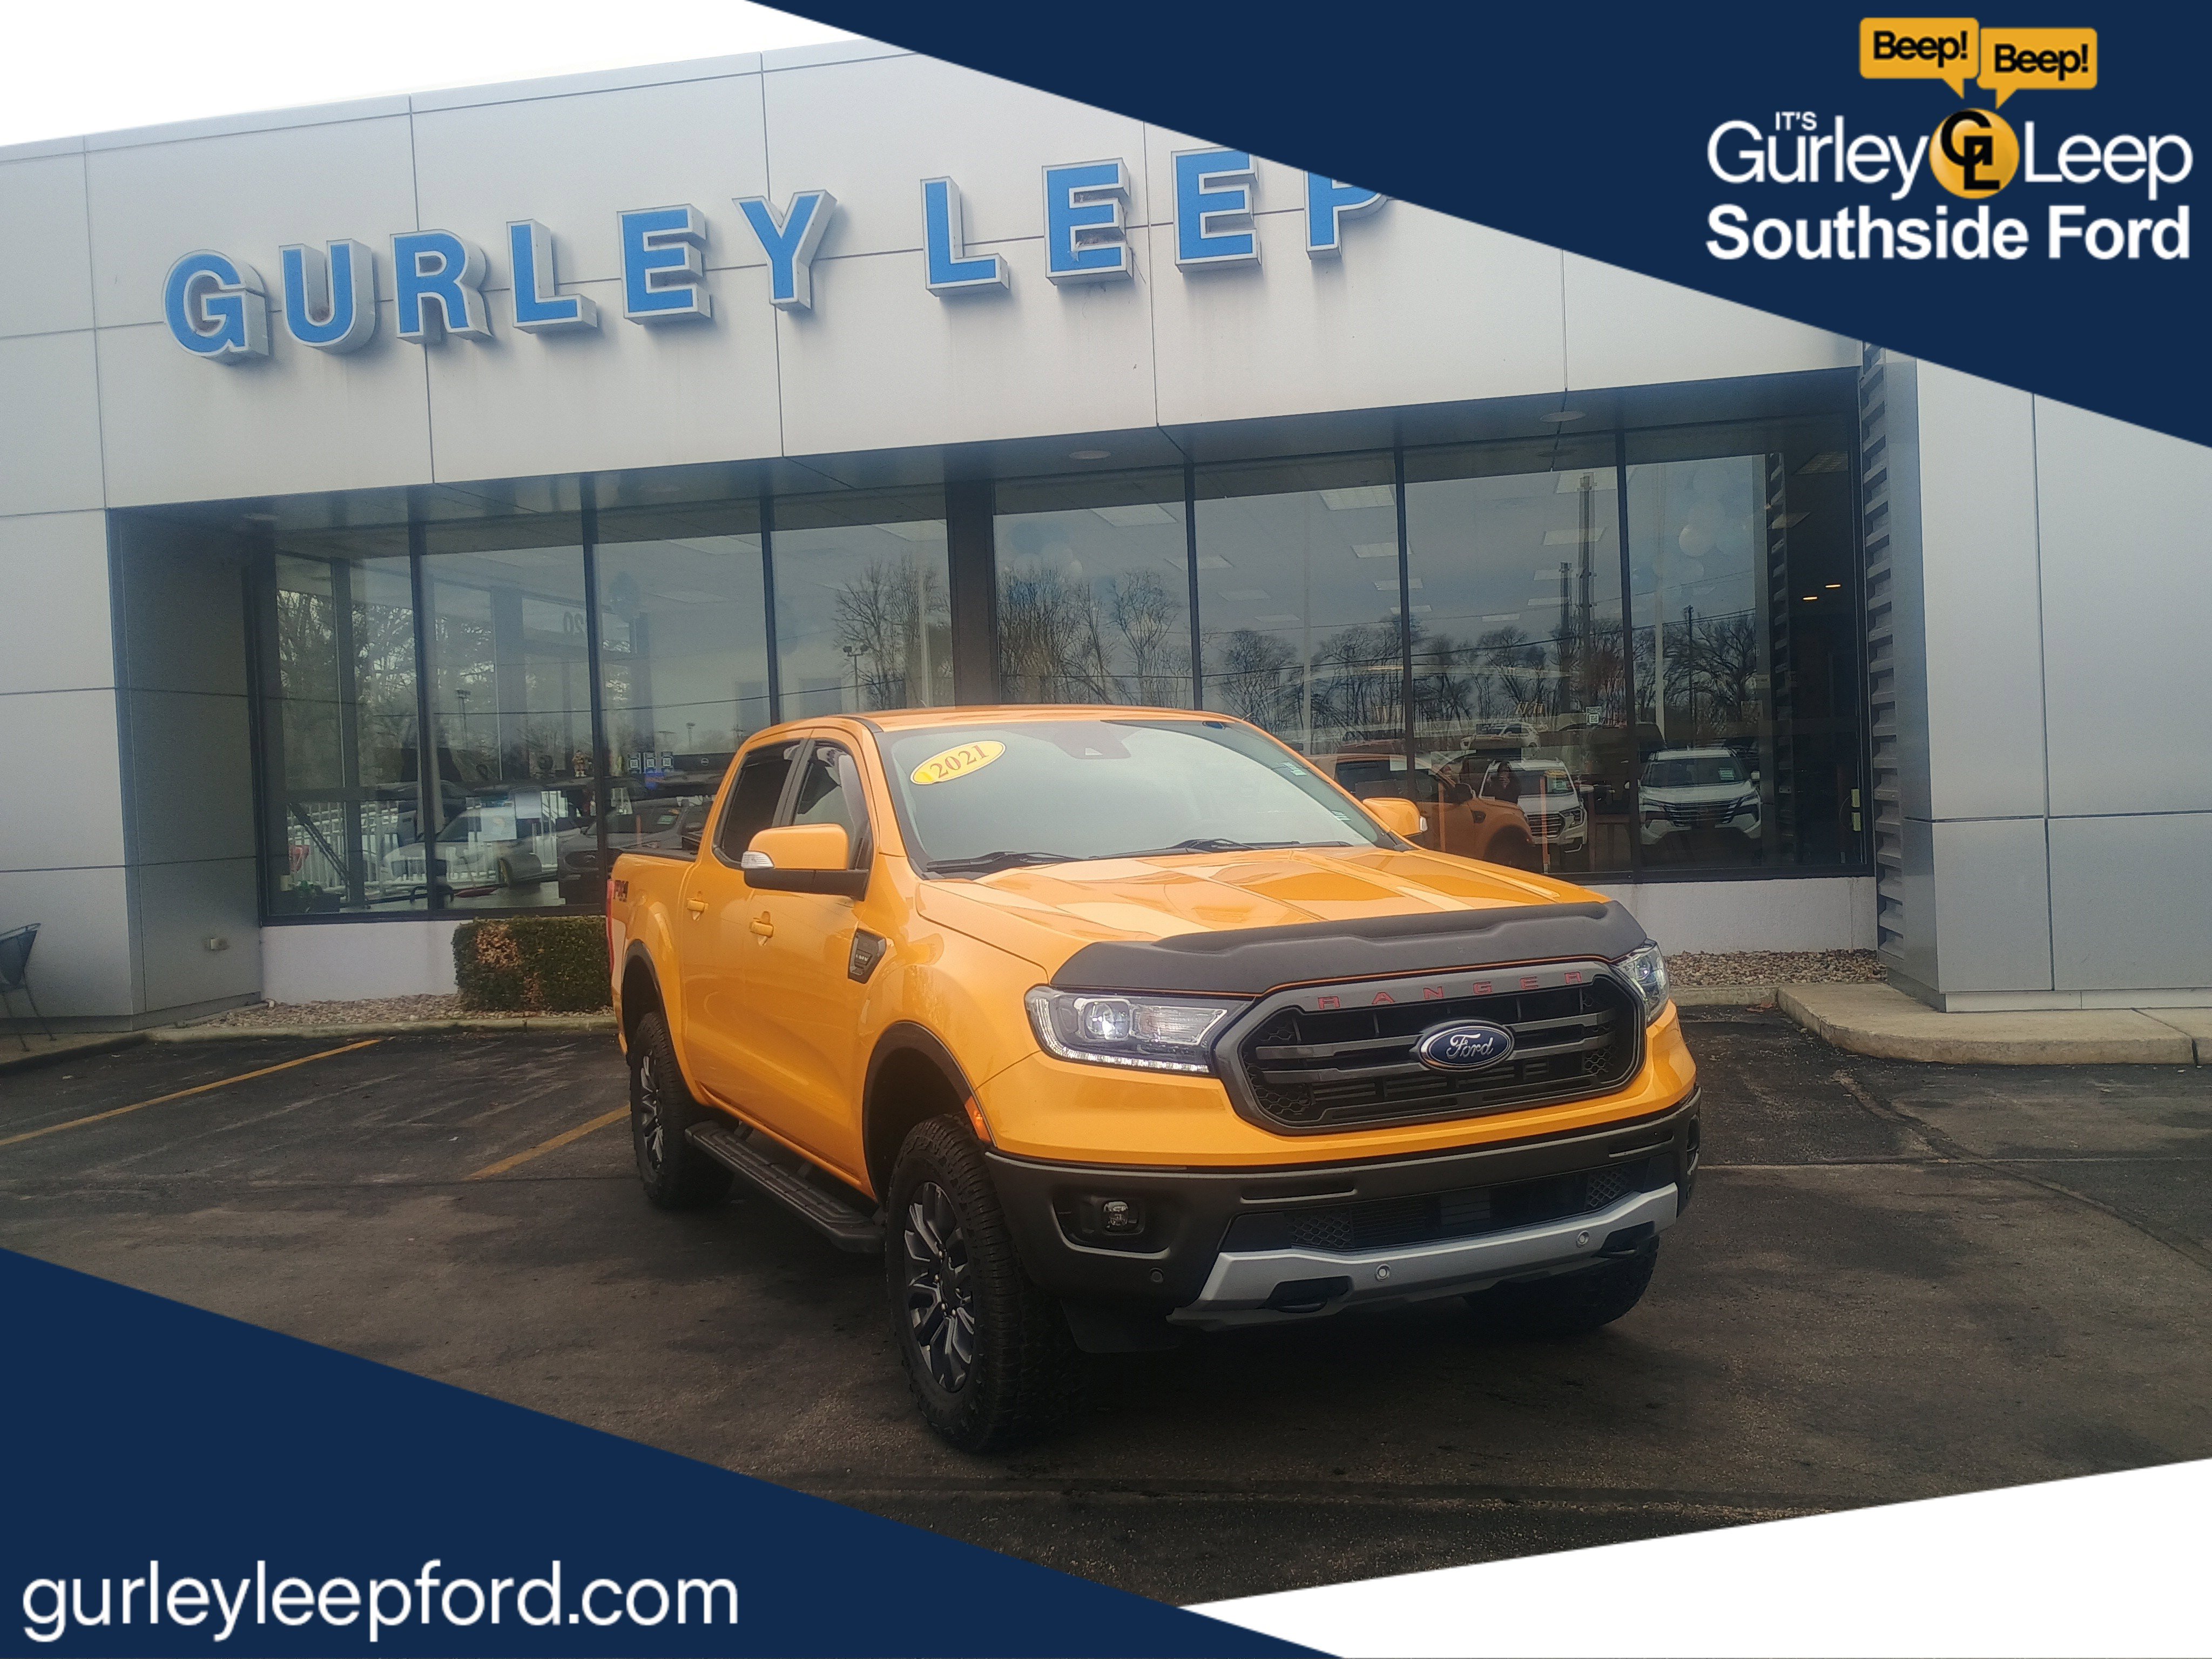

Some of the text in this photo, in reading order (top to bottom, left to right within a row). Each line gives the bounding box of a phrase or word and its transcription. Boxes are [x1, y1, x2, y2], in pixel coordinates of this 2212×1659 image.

[161, 189, 837, 365] GURLEY
[929, 745, 989, 779] 2021
[1317, 971, 1583, 1009] RANGER
[1446, 1033, 1494, 1060] Ford
